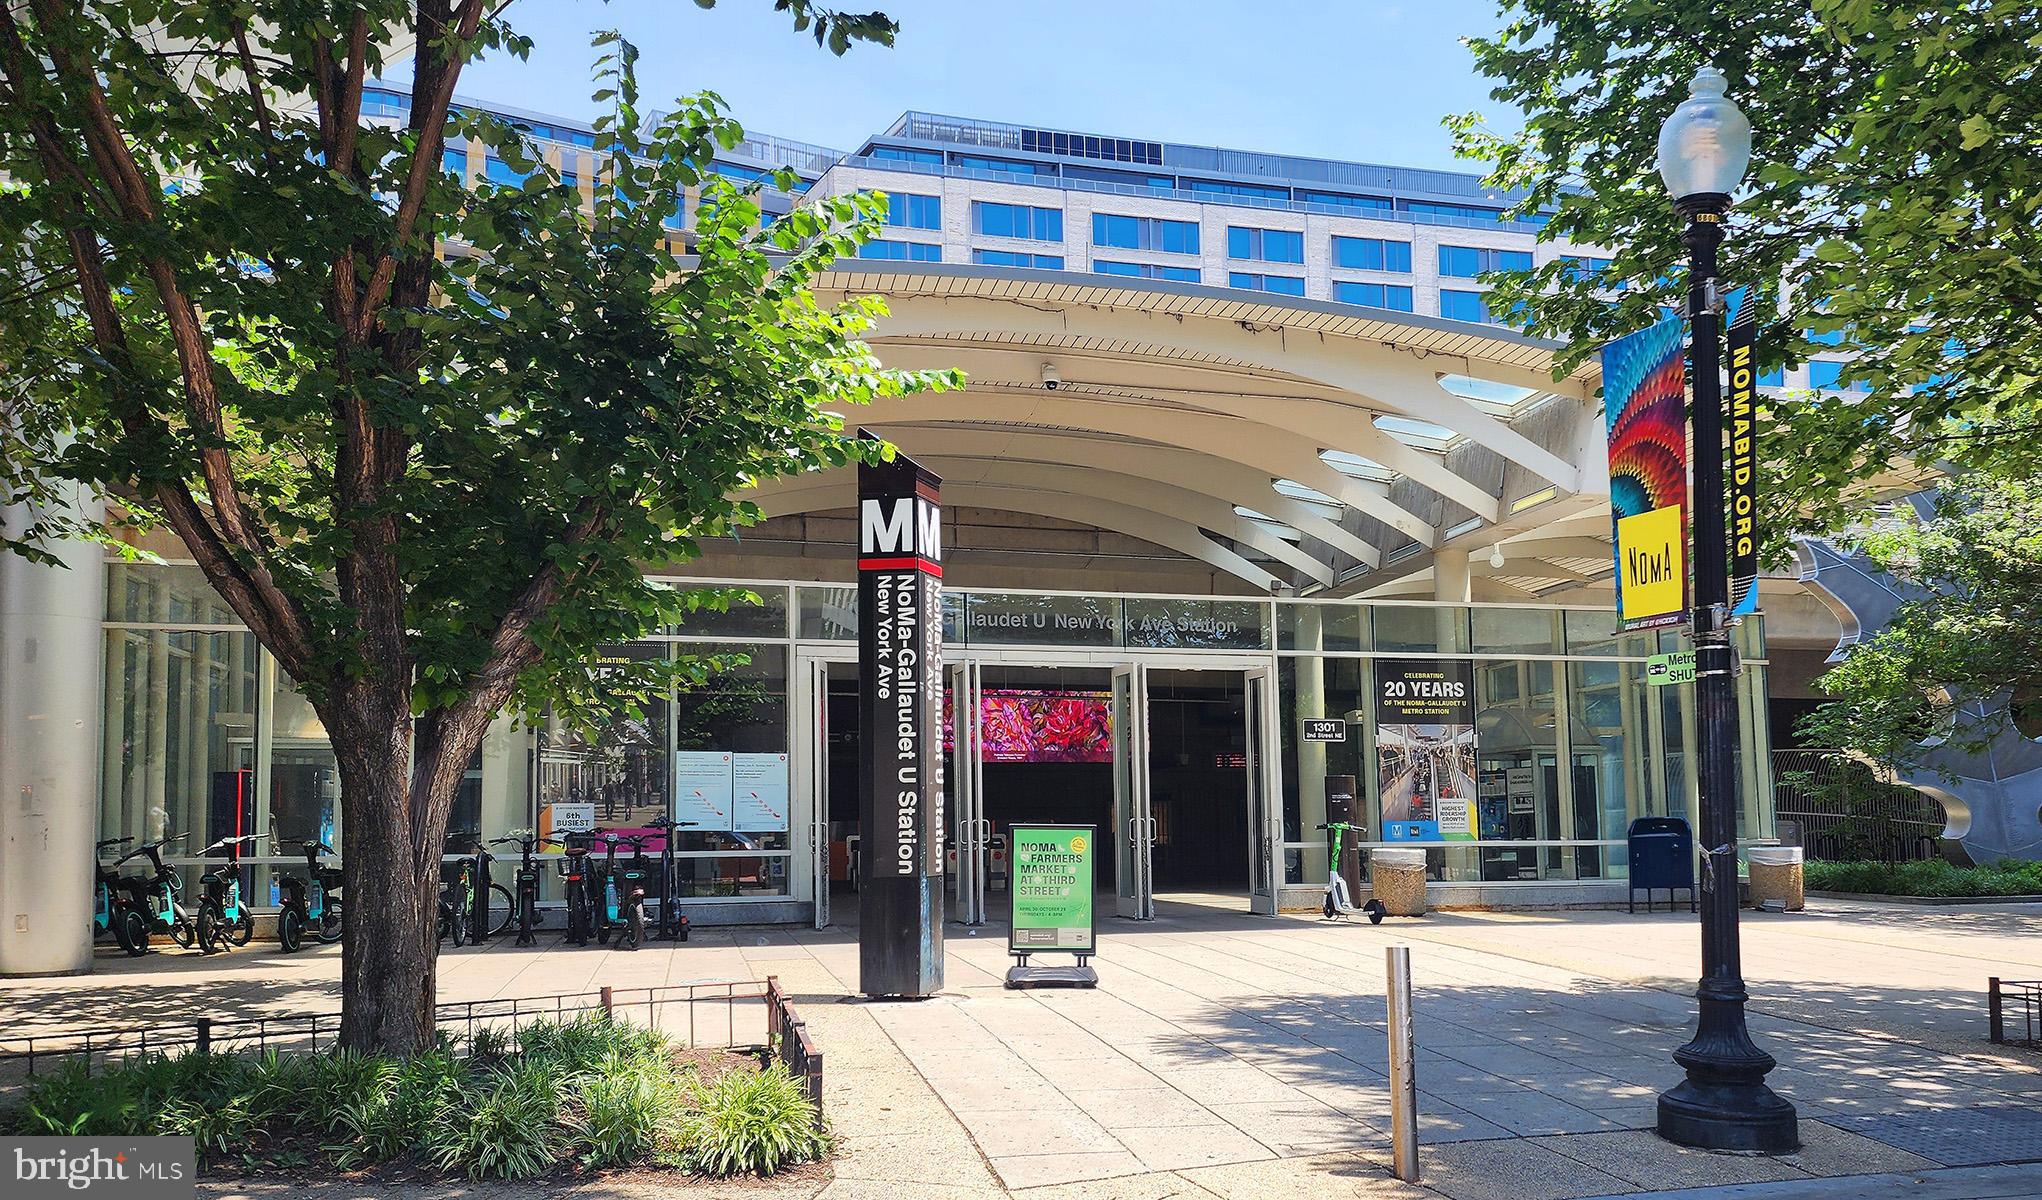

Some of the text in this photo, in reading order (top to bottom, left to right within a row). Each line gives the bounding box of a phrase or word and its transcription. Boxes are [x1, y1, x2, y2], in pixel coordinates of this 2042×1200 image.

[1733, 345, 1752, 557] NOMABID.ORG
[862, 498, 913, 553] M
[918, 499, 941, 561] M
[1033, 613, 1046, 628] U
[1055, 614, 1098, 629] New
[1139, 616, 1171, 632] Ave
[1177, 617, 1237, 633] Station
[877, 576, 893, 699] New York Ave
[926, 620, 934, 660] York
[926, 666, 934, 700] Ave
[1384, 681, 1465, 698] 20 YEARS
[897, 574, 917, 874] NoMa-Gallaudet U Station
[1313, 722, 1336, 733] 1301
[556, 819, 590, 827] BUSIEST
[566, 812, 580, 820] 6th
[935, 791, 944, 873] Station
[1021, 843, 1057, 852] NOMA
[1031, 854, 1083, 863] FARMERS
[1020, 864, 1067, 874] MARKET
[1020, 875, 1076, 885] AT THIRD
[1020, 886, 1061, 896] STREET
